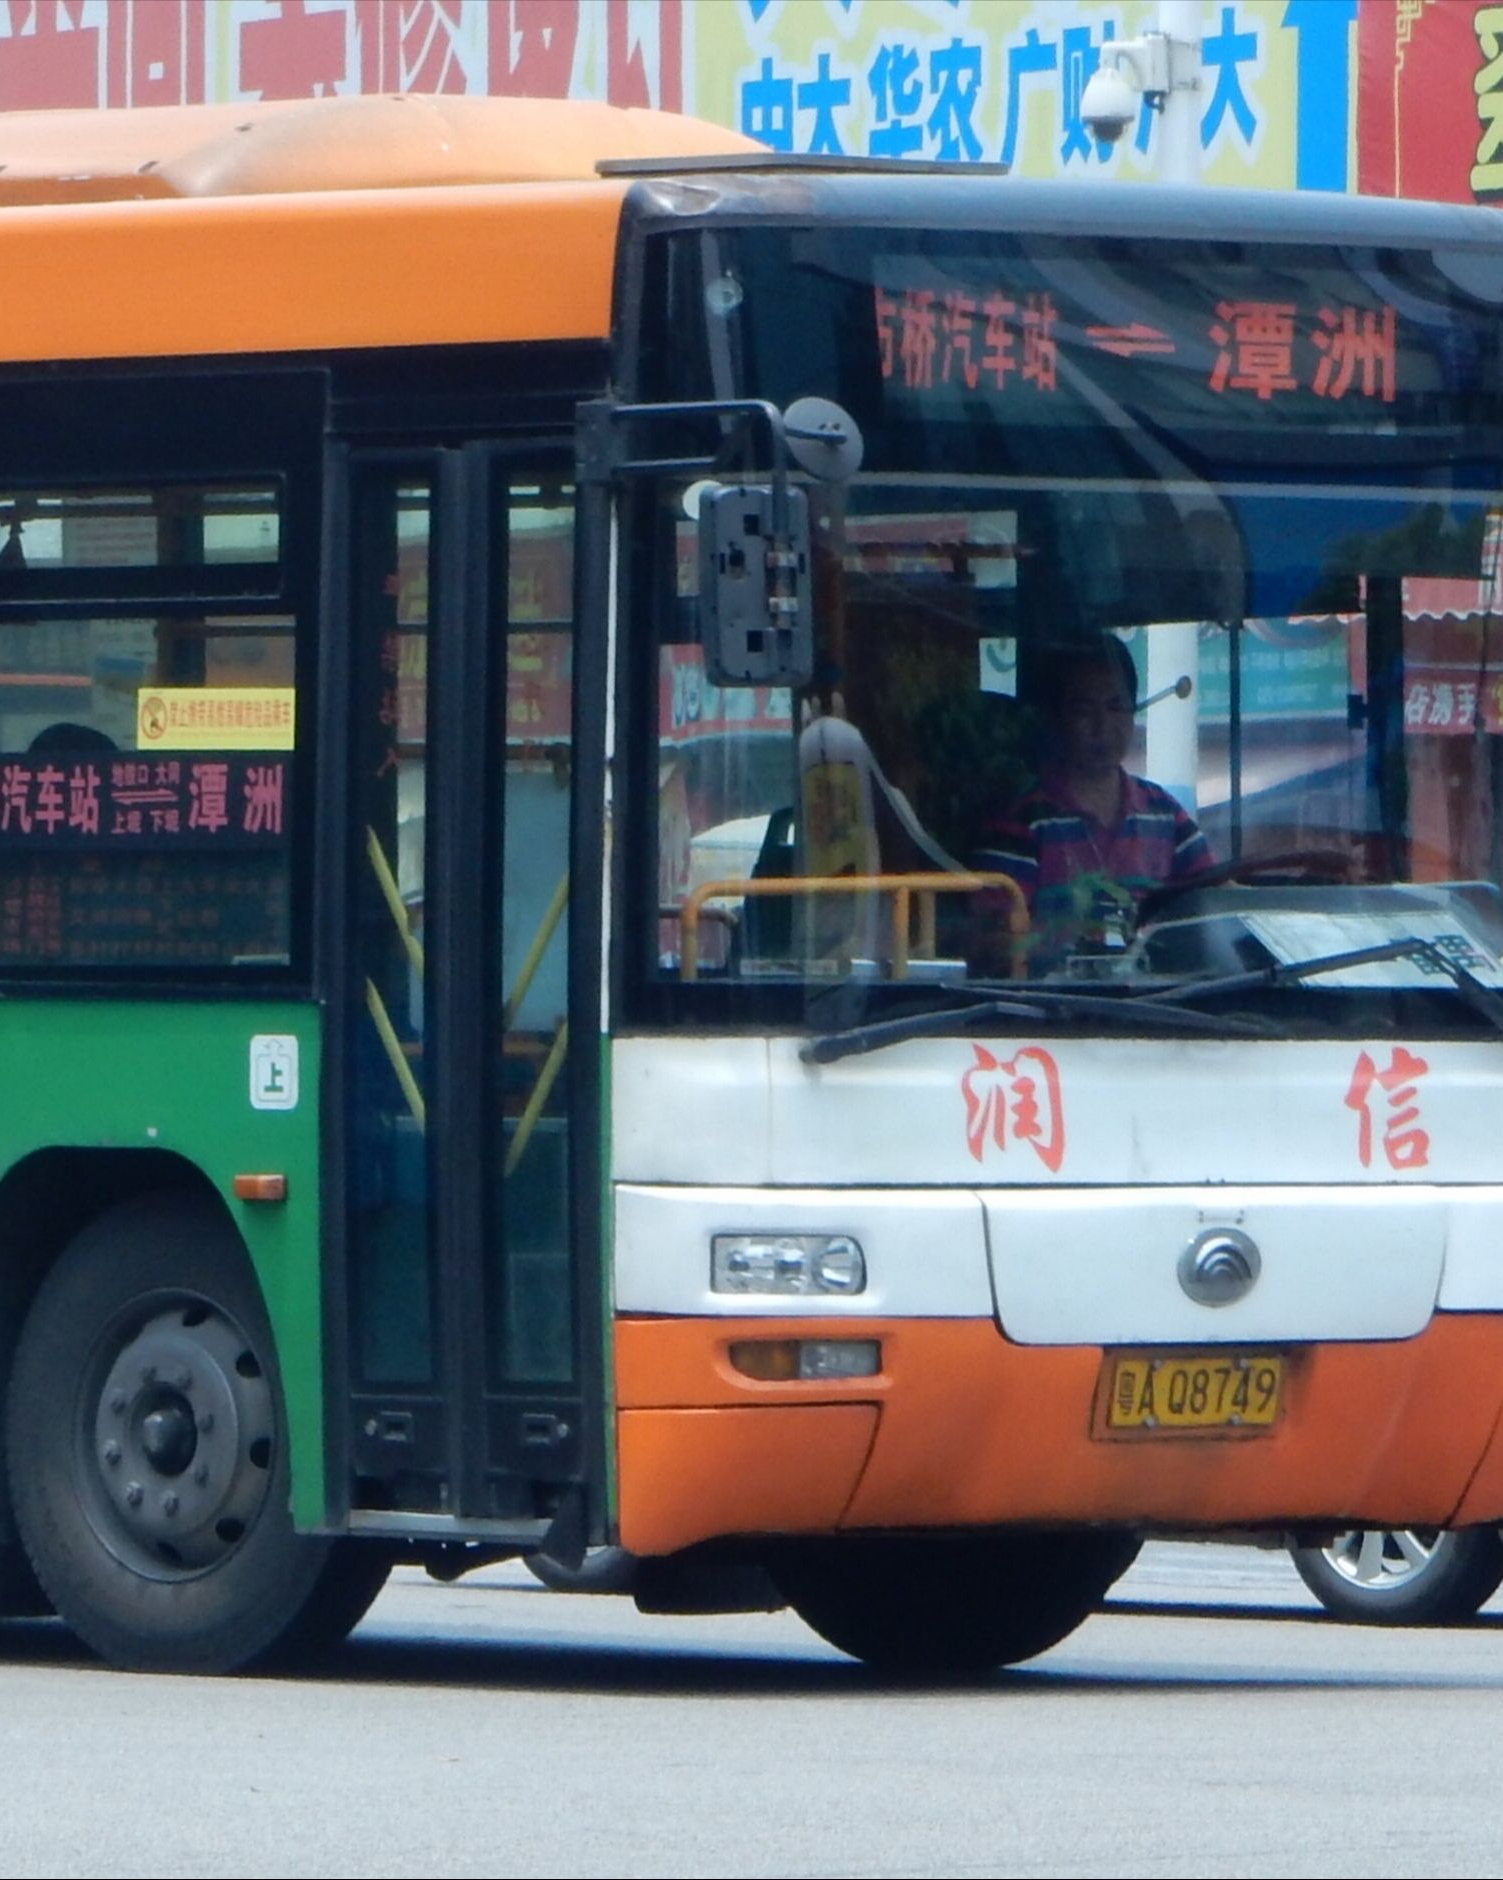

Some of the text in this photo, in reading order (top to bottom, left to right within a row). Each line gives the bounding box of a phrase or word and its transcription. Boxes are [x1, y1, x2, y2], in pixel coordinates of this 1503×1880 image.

[741, 6, 1258, 165] 中大华农广财大
[1209, 300, 1396, 402] 潭洲
[188, 763, 284, 834] 潭洲
[263, 1061, 285, 1093] 上
